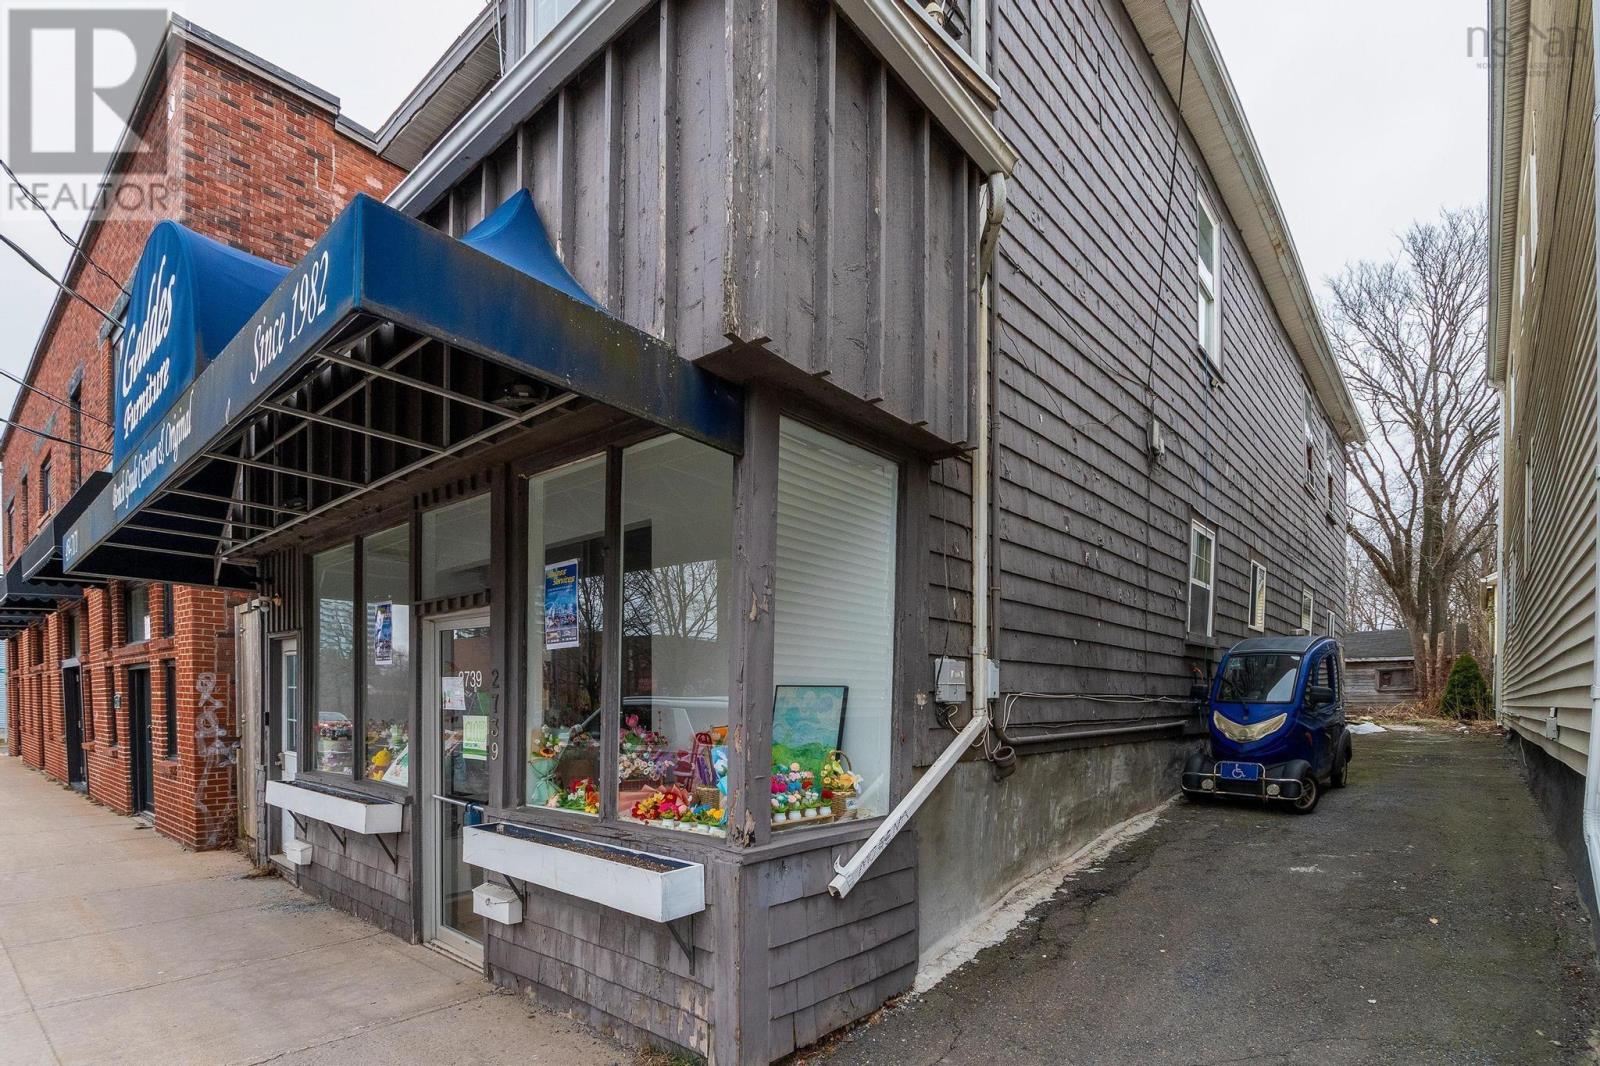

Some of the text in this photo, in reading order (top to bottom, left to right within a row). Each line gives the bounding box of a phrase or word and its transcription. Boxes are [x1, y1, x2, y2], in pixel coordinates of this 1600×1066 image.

[123, 255, 176, 397] Geddes
[138, 446, 158, 489] Custom
[165, 389, 194, 462] Original
[250, 311, 286, 385] Since
[289, 250, 329, 343] 1982
[124, 357, 170, 440] Furniture
[491, 669, 501, 761] 2739
